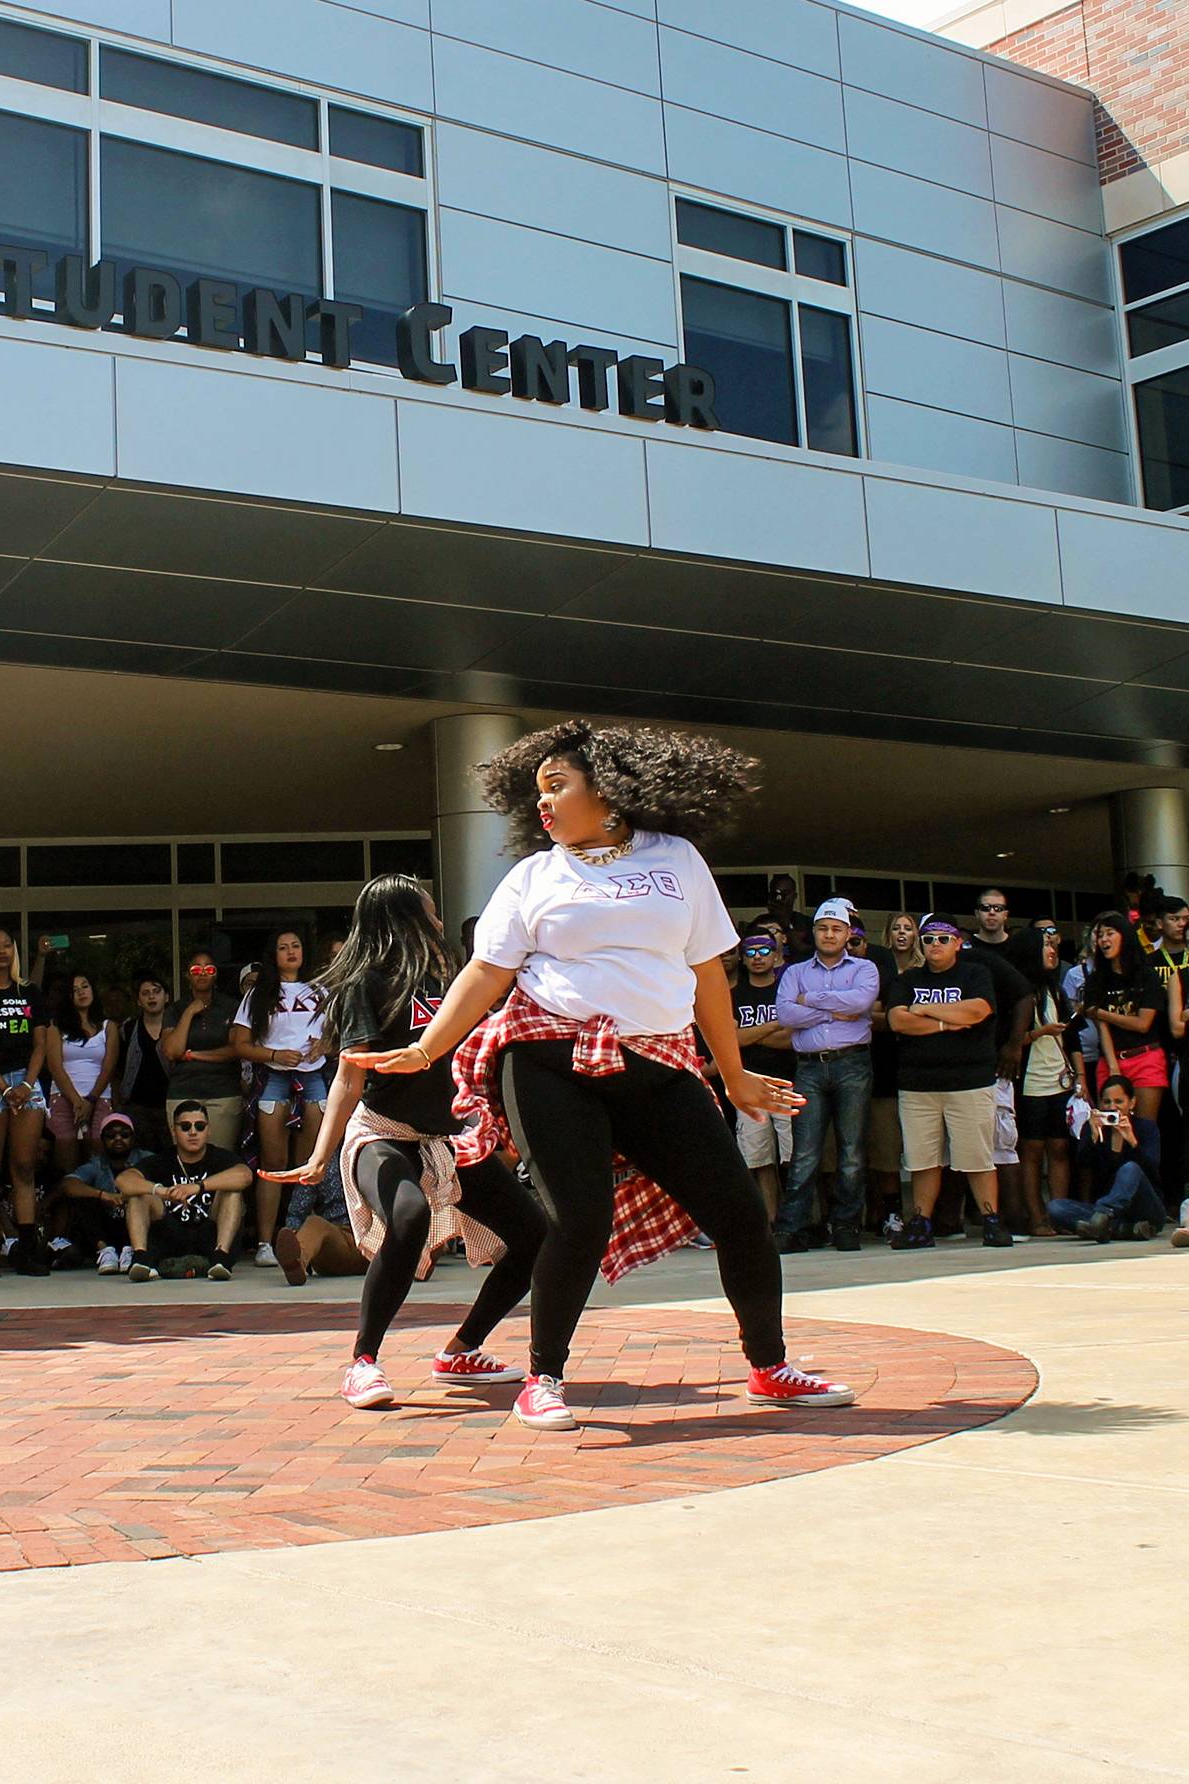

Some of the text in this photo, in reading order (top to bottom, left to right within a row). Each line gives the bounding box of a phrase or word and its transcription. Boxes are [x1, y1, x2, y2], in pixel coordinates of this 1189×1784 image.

[397, 302, 720, 431] CENTER
[2, 998, 28, 1006] SOME
[9, 1018, 30, 1034] EA
